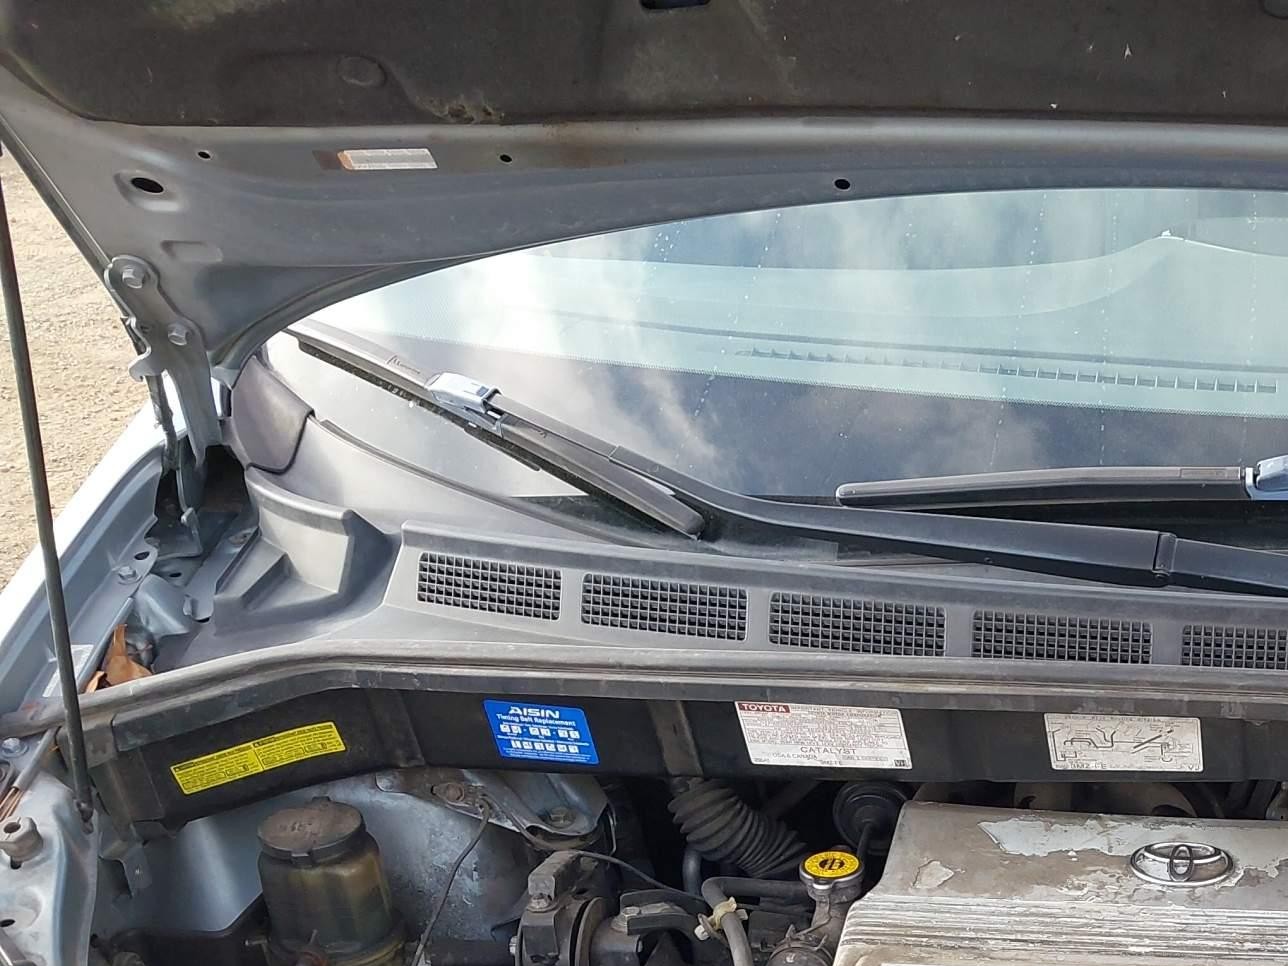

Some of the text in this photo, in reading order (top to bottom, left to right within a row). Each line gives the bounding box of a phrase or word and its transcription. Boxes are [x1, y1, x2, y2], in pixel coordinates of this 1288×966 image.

[509, 706, 560, 719] AISIN
[742, 703, 786, 712] TOYOTA
[496, 713, 519, 722] Timing
[534, 717, 576, 727] Replacement
[800, 746, 856, 755] CATALYST
